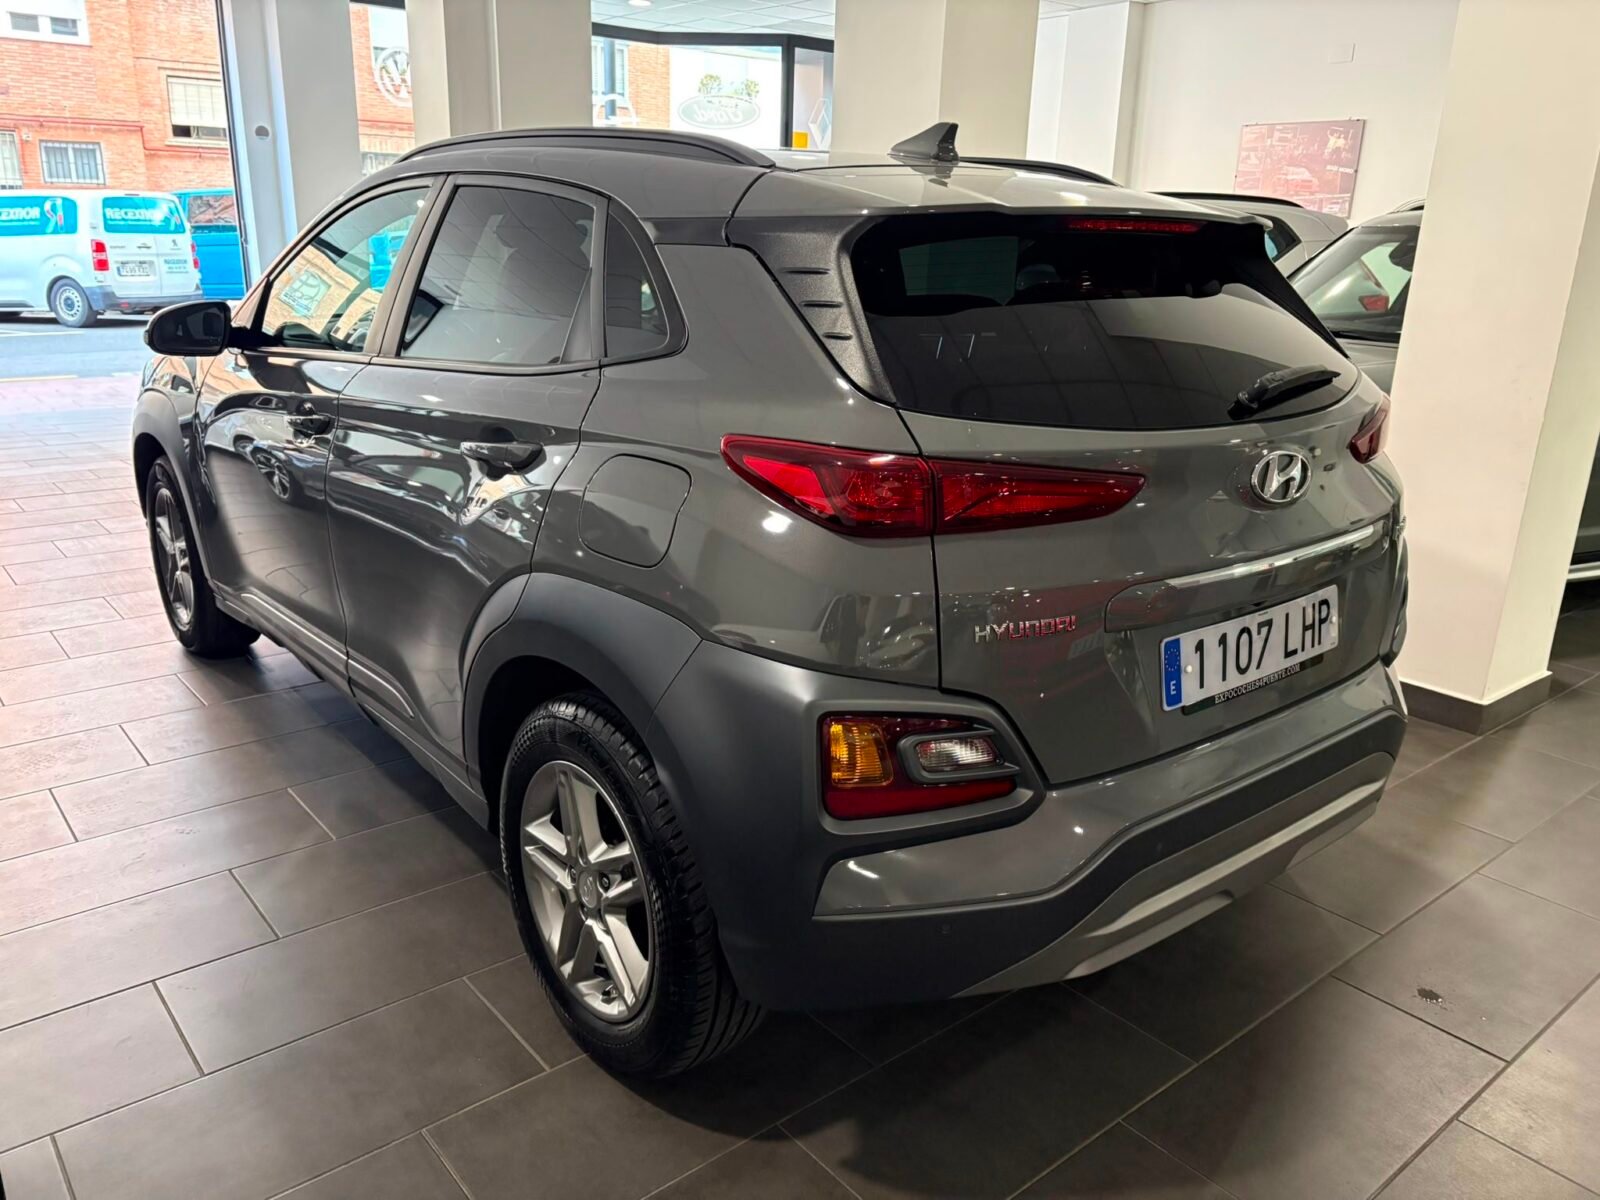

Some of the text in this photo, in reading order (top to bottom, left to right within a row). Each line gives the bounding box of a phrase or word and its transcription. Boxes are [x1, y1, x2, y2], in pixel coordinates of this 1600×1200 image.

[974, 615, 1077, 643] HYUNDAI
[1194, 598, 1331, 690] 1107 LHP
[1170, 680, 1177, 695] E
